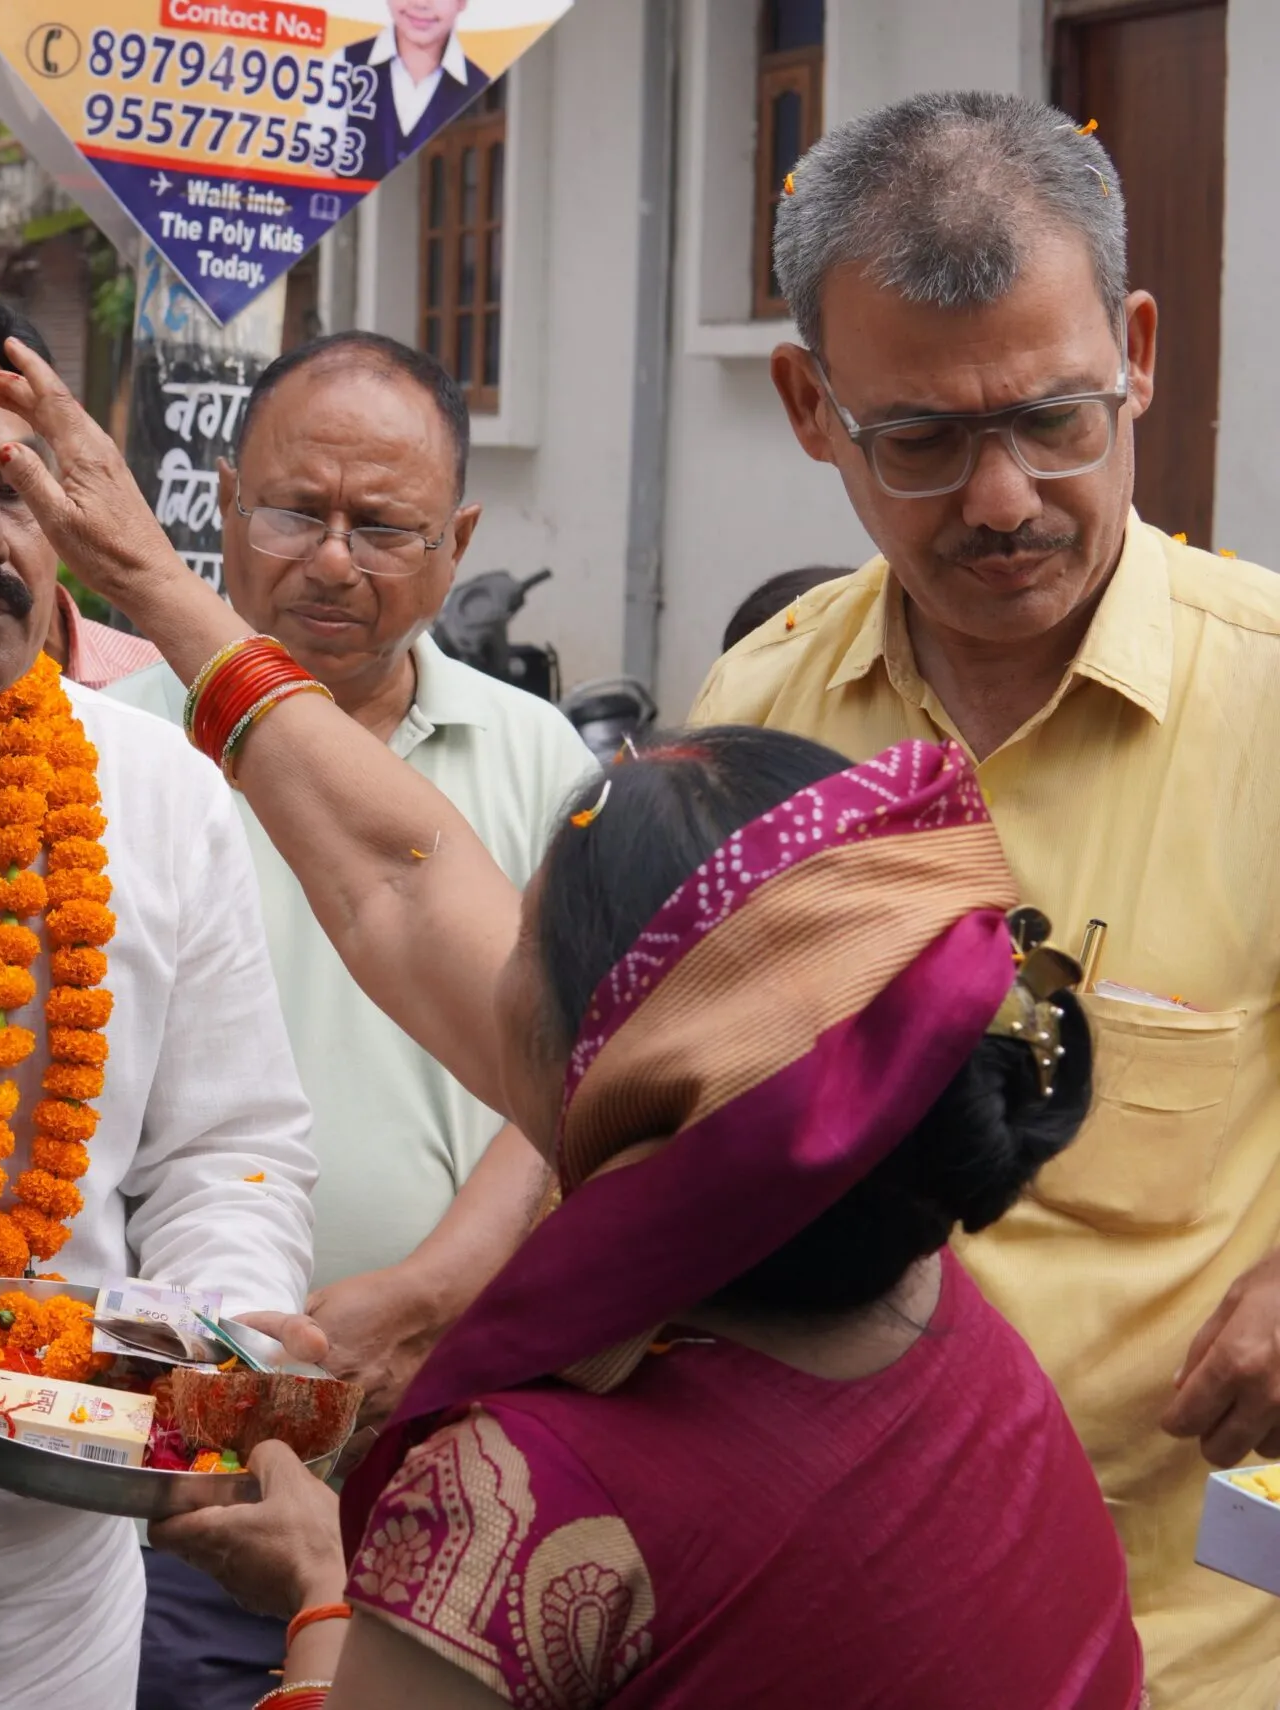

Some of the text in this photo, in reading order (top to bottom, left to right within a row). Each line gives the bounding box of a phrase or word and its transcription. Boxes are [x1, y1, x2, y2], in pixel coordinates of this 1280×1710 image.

[169, 0, 269, 33] Contact
[88, 28, 379, 118] 8979490552
[84, 92, 367, 175] 9557775533
[186, 179, 286, 217] Walk into
[159, 211, 304, 254] The Poly Kids
[197, 250, 265, 289] Today.
